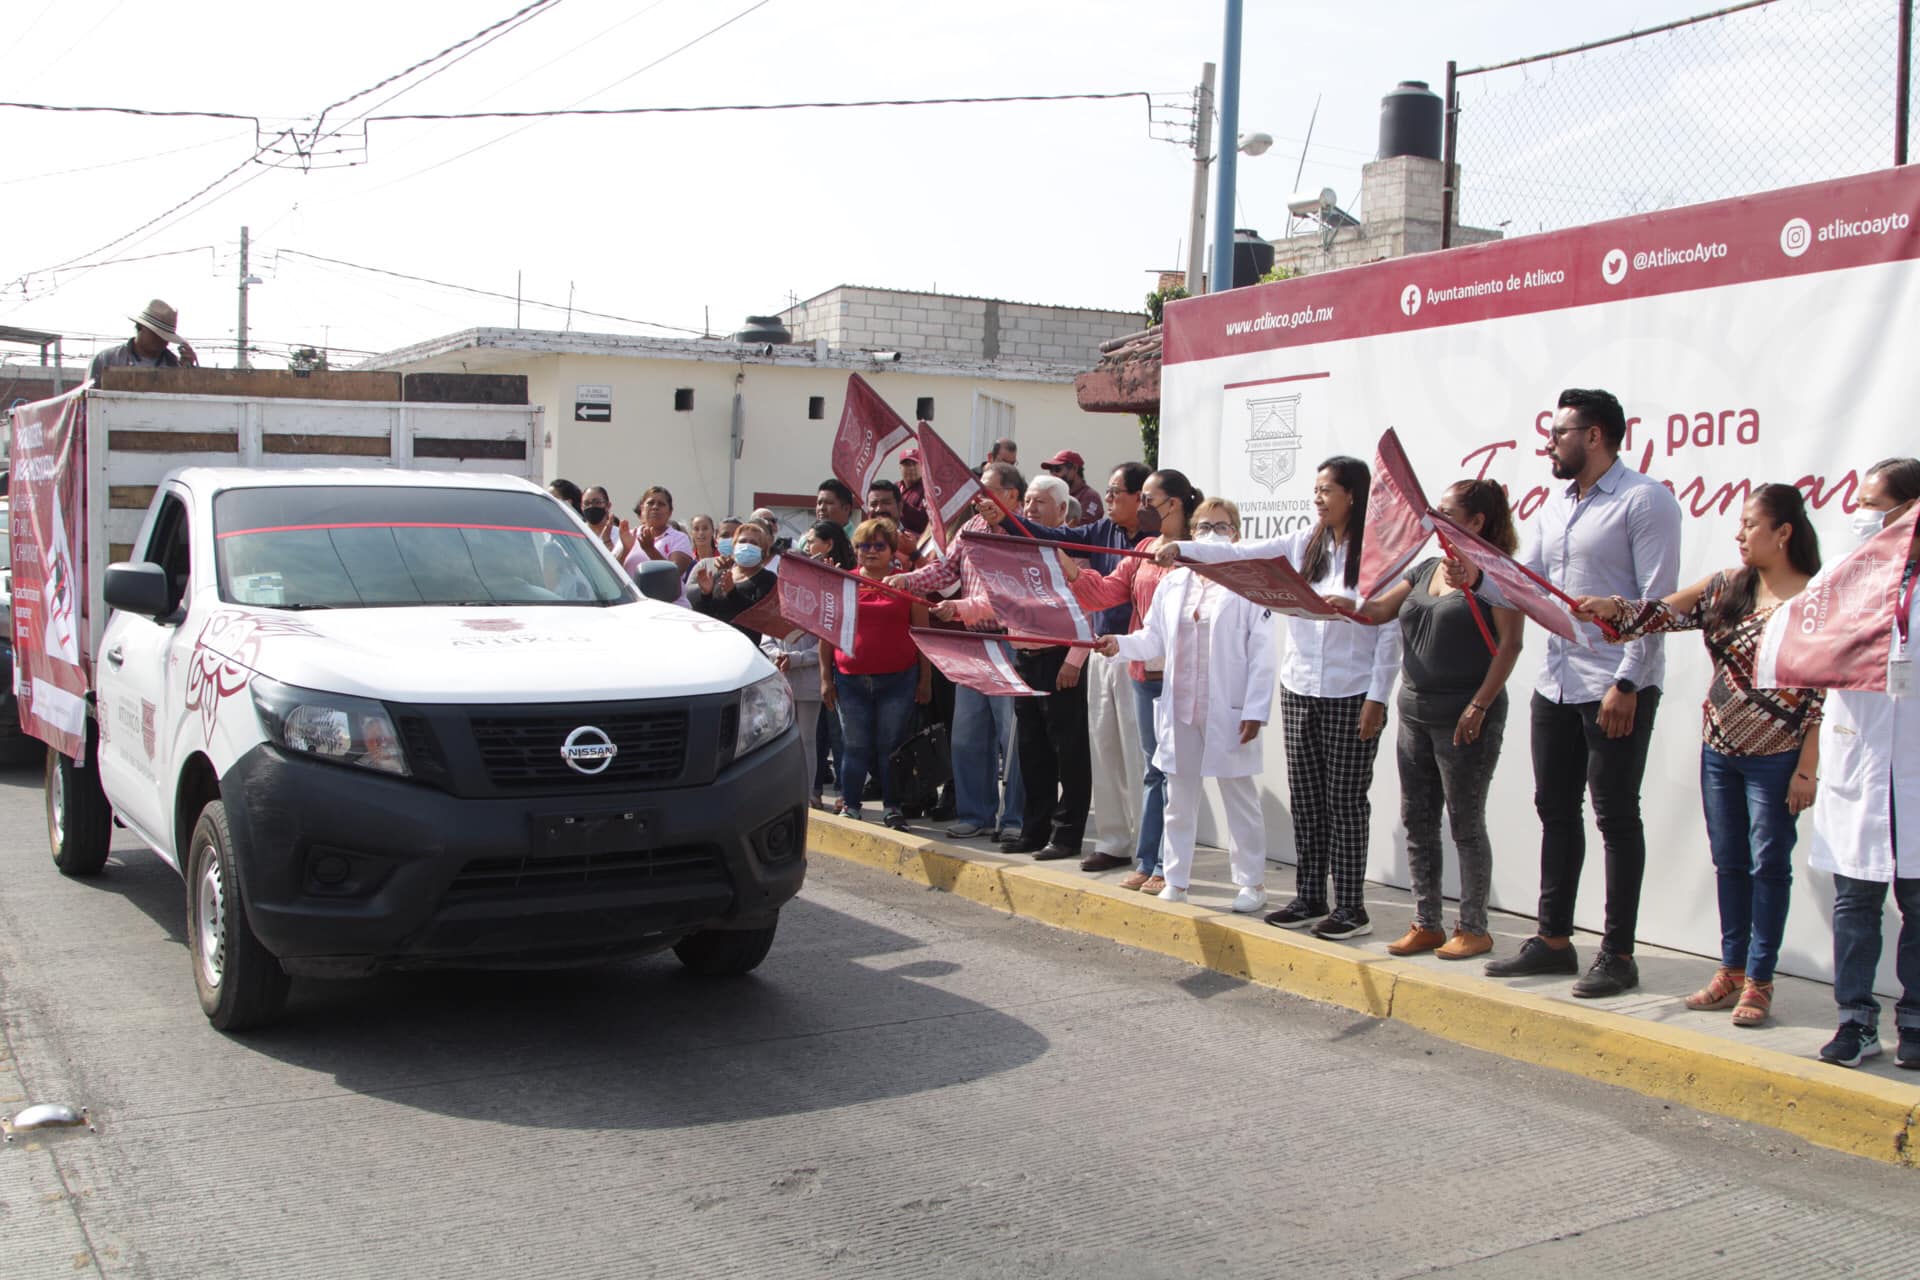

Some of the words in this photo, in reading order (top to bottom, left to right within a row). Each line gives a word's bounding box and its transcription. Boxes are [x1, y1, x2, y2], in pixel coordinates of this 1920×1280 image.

[1818, 213, 1909, 241] atlixcoayto
[1633, 243, 1728, 271] @AtlixcoAyto
[1427, 281, 1503, 305] Ayuntamiento
[1507, 274, 1520, 291] de
[1524, 269, 1565, 288] Atlixco
[1226, 305, 1334, 336] www.atlixco.gob.mx
[1667, 408, 1760, 456] para
[1239, 500, 1299, 512] YUNTAMIENTO
[1300, 499, 1310, 511] DE
[1239, 515, 1310, 539] TLIXCO
[822, 592, 834, 632] ATLIXCO
[568, 747, 613, 757] NISSAN
